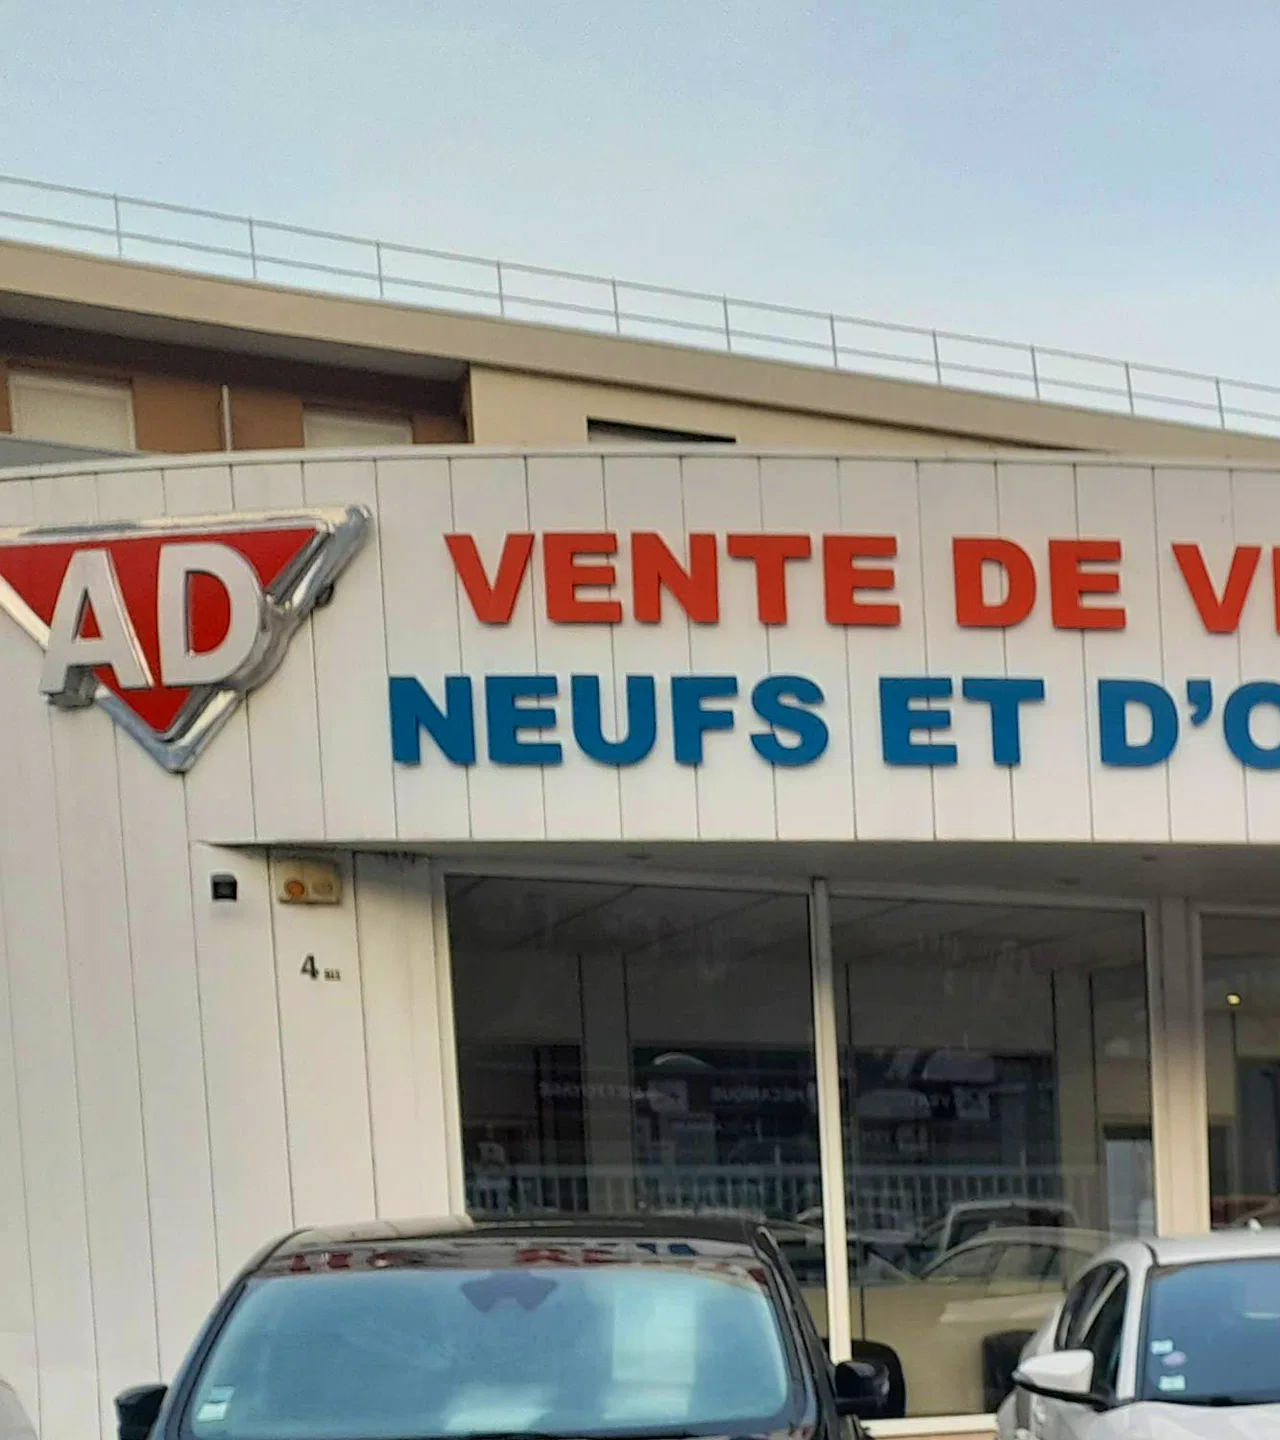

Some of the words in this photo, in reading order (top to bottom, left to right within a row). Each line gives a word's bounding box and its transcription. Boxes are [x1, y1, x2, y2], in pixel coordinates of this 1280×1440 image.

[40, 541, 263, 694] AD
[444, 532, 901, 626] VENTE
[952, 536, 1126, 630] DE
[389, 674, 830, 767] NEUFS
[879, 676, 1045, 767] ET
[301, 954, 319, 979] 4
